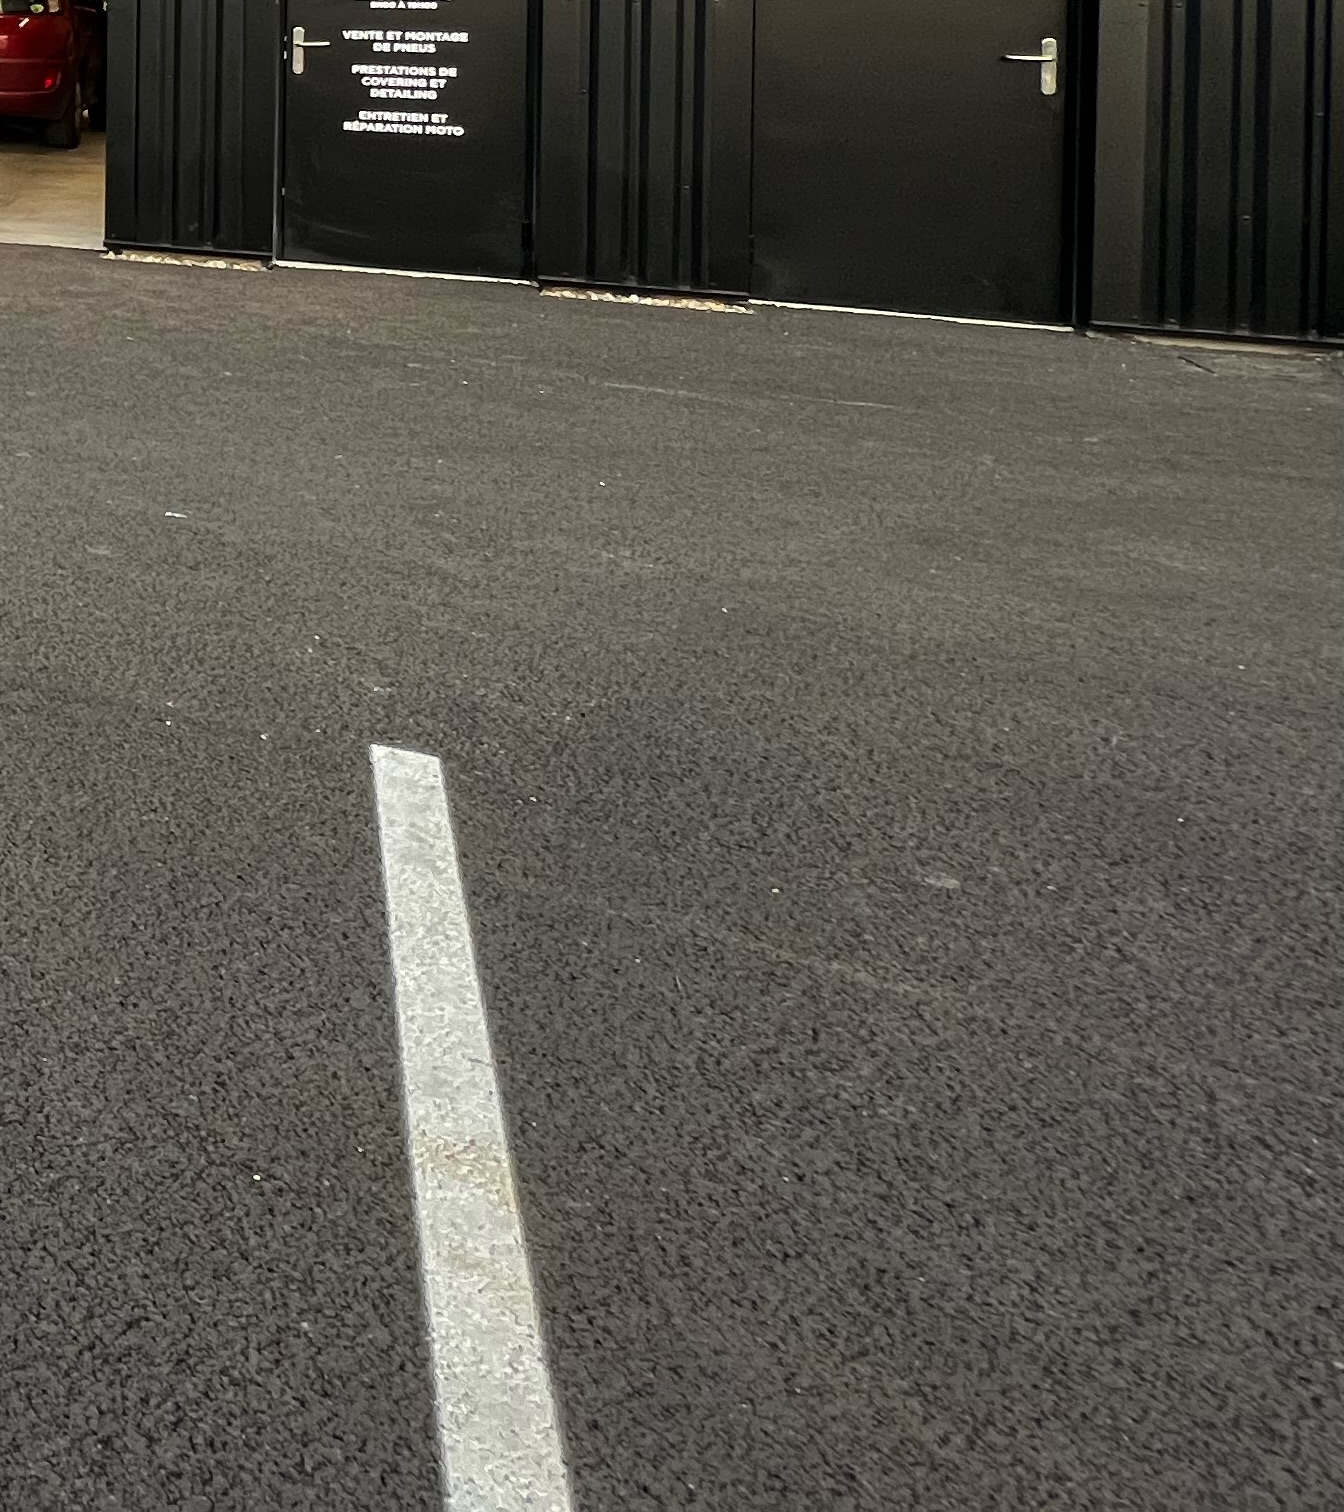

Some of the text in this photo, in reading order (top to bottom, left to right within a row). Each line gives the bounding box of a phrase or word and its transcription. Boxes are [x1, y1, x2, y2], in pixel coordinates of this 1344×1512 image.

[342, 30, 469, 43] VENTE ET MONTAGE
[372, 42, 437, 53] DE PNEUS
[351, 64, 458, 78] PRESTATIONS DE
[361, 76, 447, 89] COVERING ET
[358, 110, 448, 124] ENTRETIEN ET
[425, 125, 465, 137] MOTO
